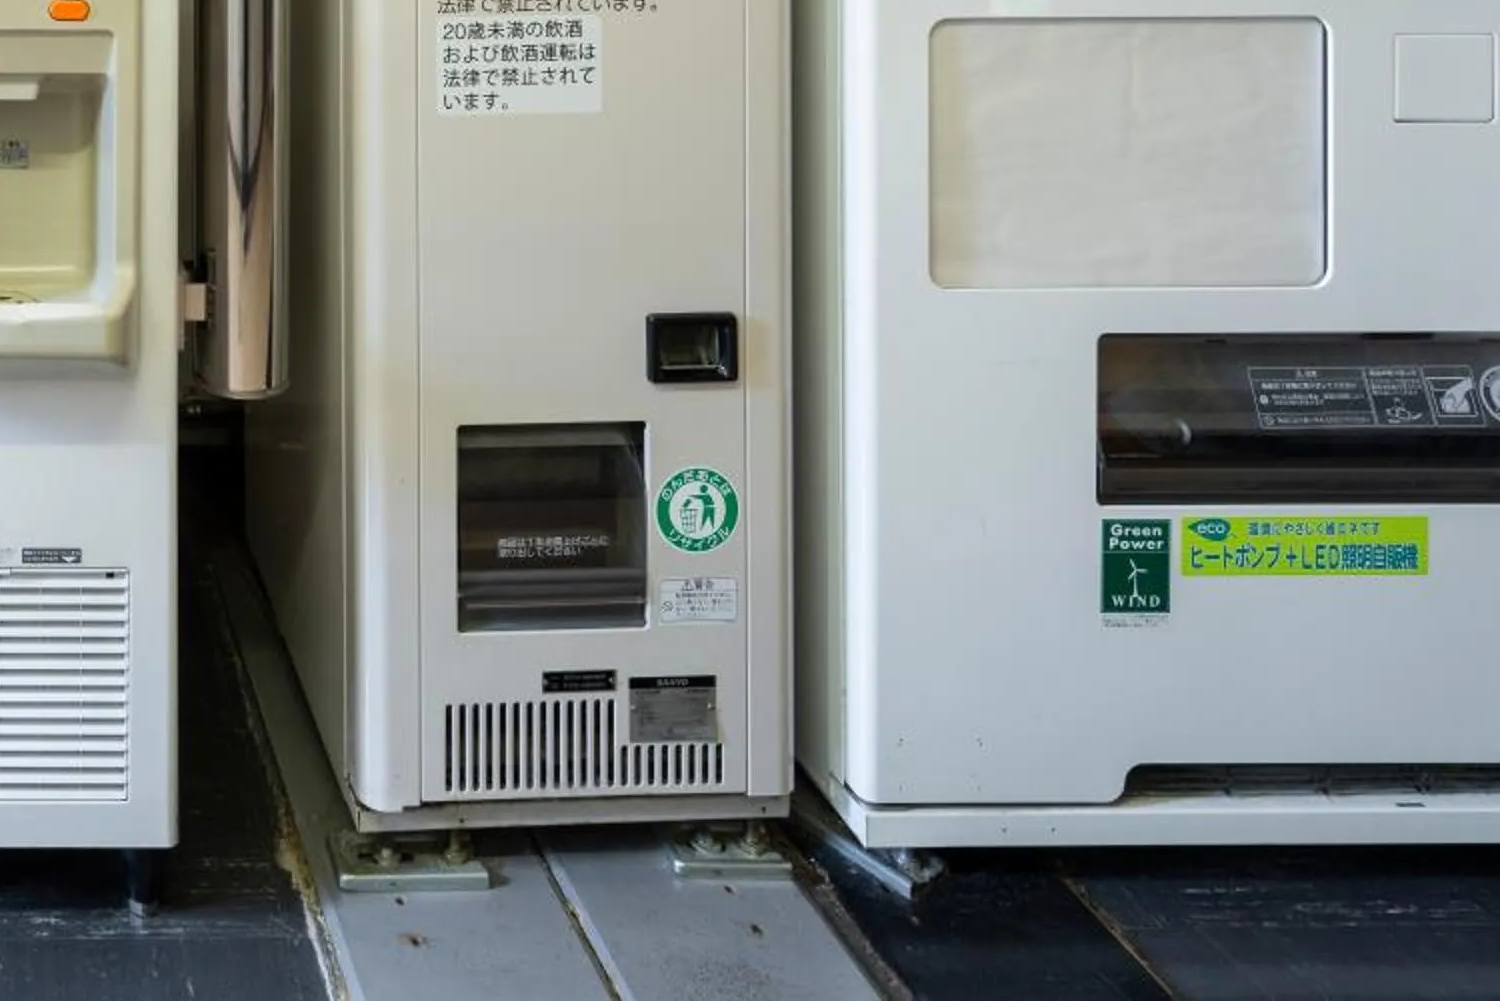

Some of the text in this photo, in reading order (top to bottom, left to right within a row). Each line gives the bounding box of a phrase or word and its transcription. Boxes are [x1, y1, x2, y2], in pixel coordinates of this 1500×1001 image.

[443, 20, 583, 39] 20歳未満の飲酒
[443, 44, 596, 64] および飲酒運転は
[443, 67, 597, 87] 法律で禁止されて
[443, 93, 509, 111] います。
[1110, 523, 1162, 537] Green
[1197, 521, 1226, 535] eco
[1109, 537, 1164, 552] Power
[1111, 594, 1161, 608] WIND
